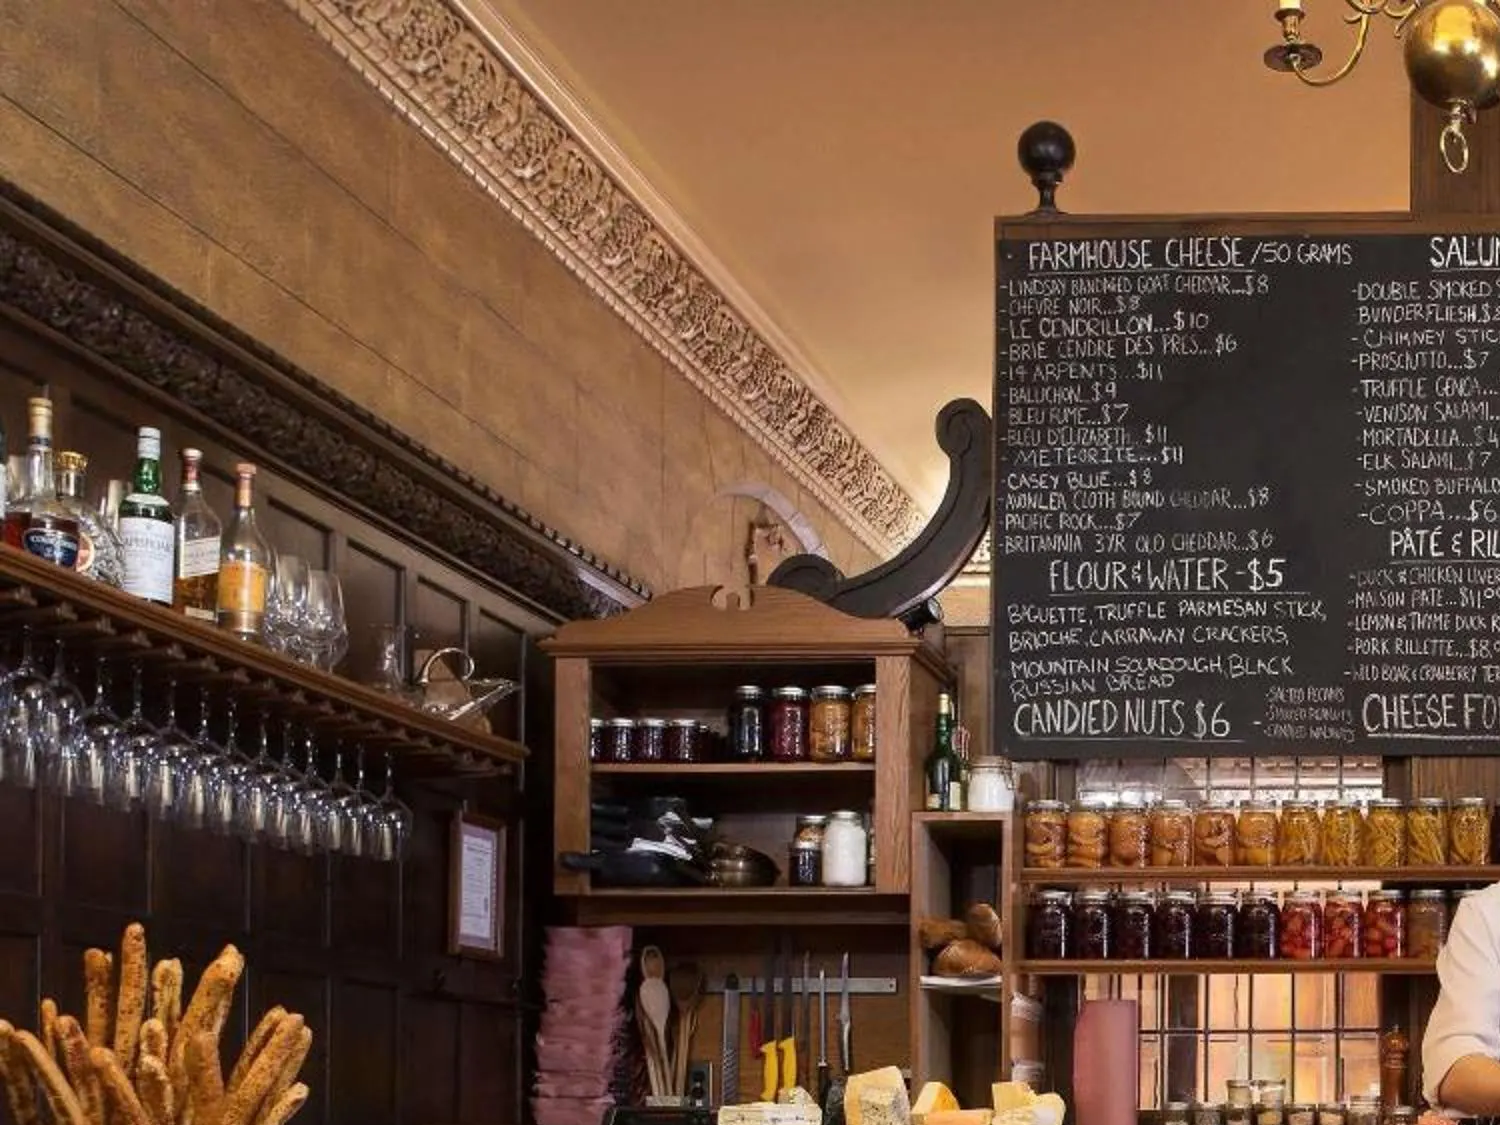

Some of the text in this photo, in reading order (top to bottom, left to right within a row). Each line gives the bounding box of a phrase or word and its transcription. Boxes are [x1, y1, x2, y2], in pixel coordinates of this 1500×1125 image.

[1028, 239, 1152, 270] FARMHOUSE
[1165, 235, 1245, 267] CHEESE
[1297, 243, 1353, 265] GRAMS
[1357, 280, 1421, 301] DOUBLE
[1427, 279, 1492, 301] SMOKED
[1009, 318, 1032, 339] LE
[1009, 343, 1048, 361] BRIE
[1125, 336, 1154, 356] DES
[1359, 377, 1428, 400] TRUFFLE
[1362, 452, 1396, 471] ELK
[1007, 473, 1059, 490] CASEY
[1365, 477, 1429, 497] SMOKED
[1073, 491, 1116, 510] CLOTH
[1135, 533, 1165, 554] OLD
[1451, 531, 1463, 557] &
[1049, 559, 1128, 592] FLOUR
[1147, 557, 1229, 592] WATER
[1094, 600, 1167, 621] TRUFFLE
[1178, 598, 1267, 618] PARMESAN
[1355, 638, 1390, 656] PORK
[1010, 657, 1110, 679] MOUNTAIN
[1228, 653, 1294, 679] BLACK
[1010, 674, 1176, 703] RUSSIAN BREAD
[1013, 700, 1119, 736] CANDIED
[1125, 699, 1185, 735] NUTS
[1193, 700, 1231, 740] $6
[1362, 693, 1457, 731] CHEESE
